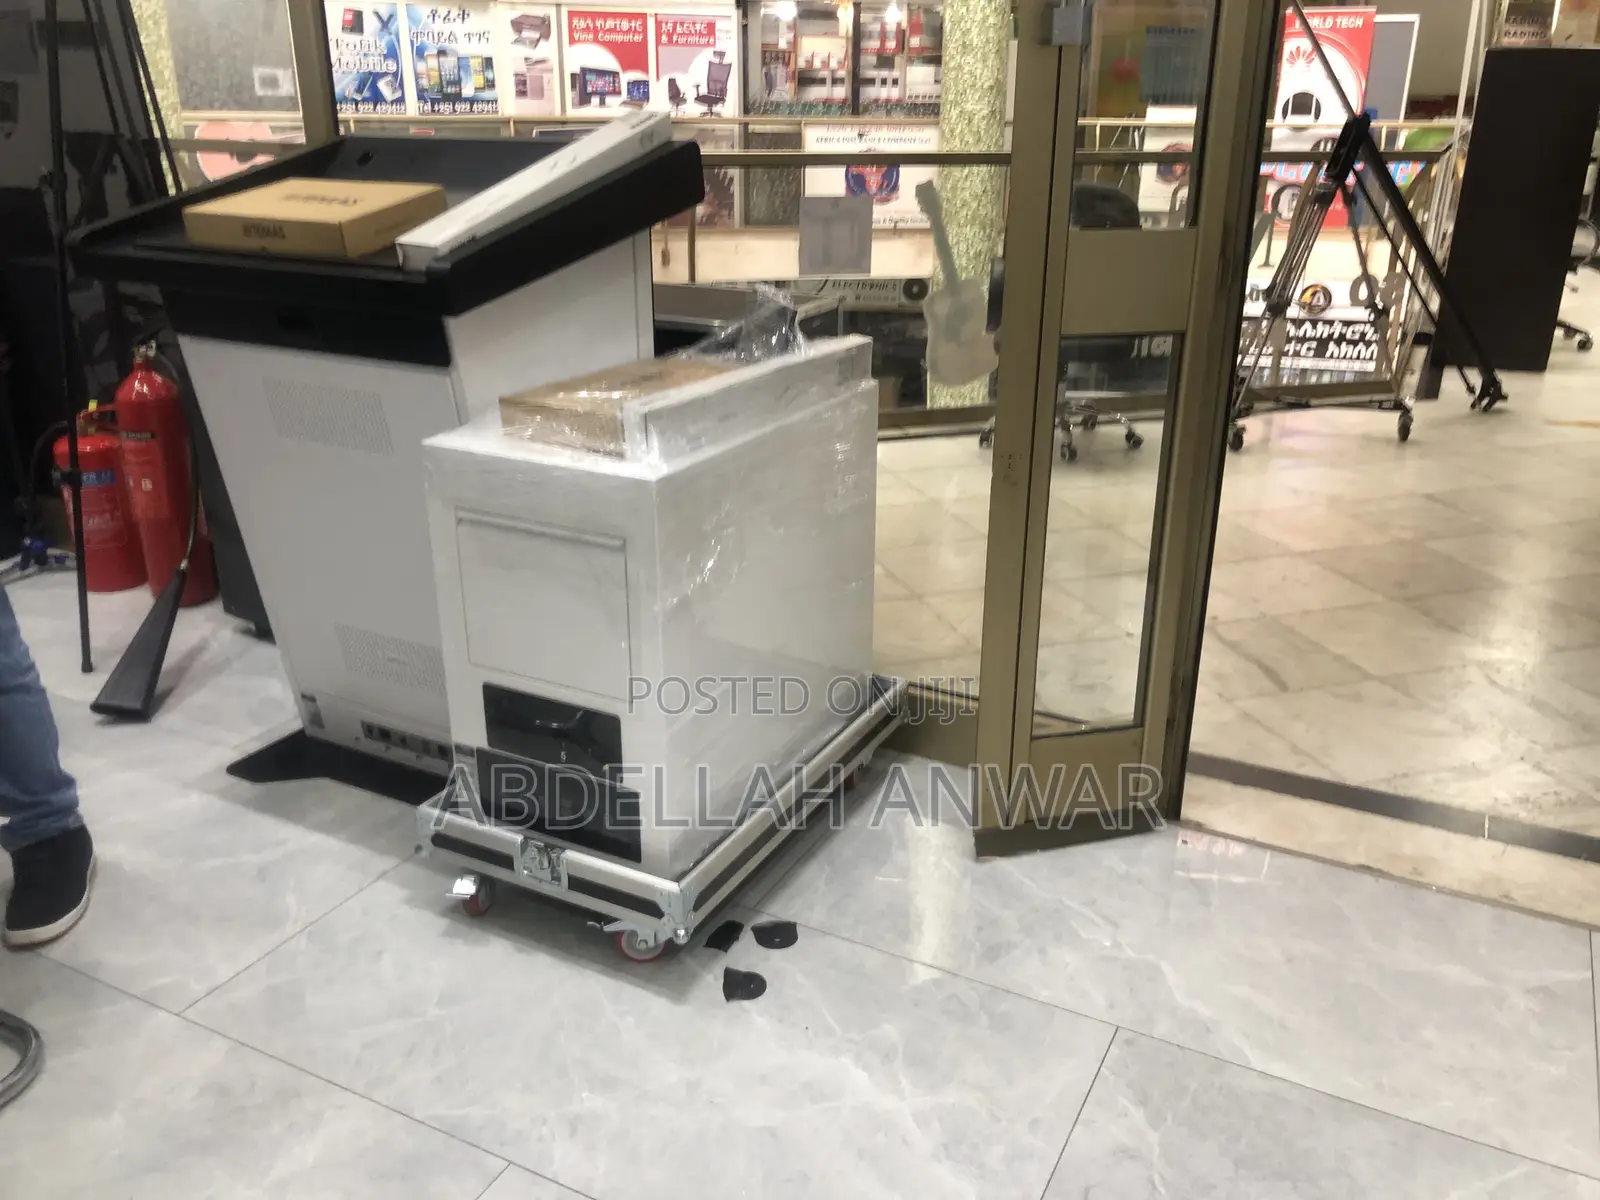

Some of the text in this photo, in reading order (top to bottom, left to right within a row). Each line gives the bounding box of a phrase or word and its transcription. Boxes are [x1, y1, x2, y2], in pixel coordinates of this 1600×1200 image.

[1336, 16, 1364, 29] TECH
[573, 31, 645, 43] Vine Computer
[672, 34, 716, 45] Furniture
